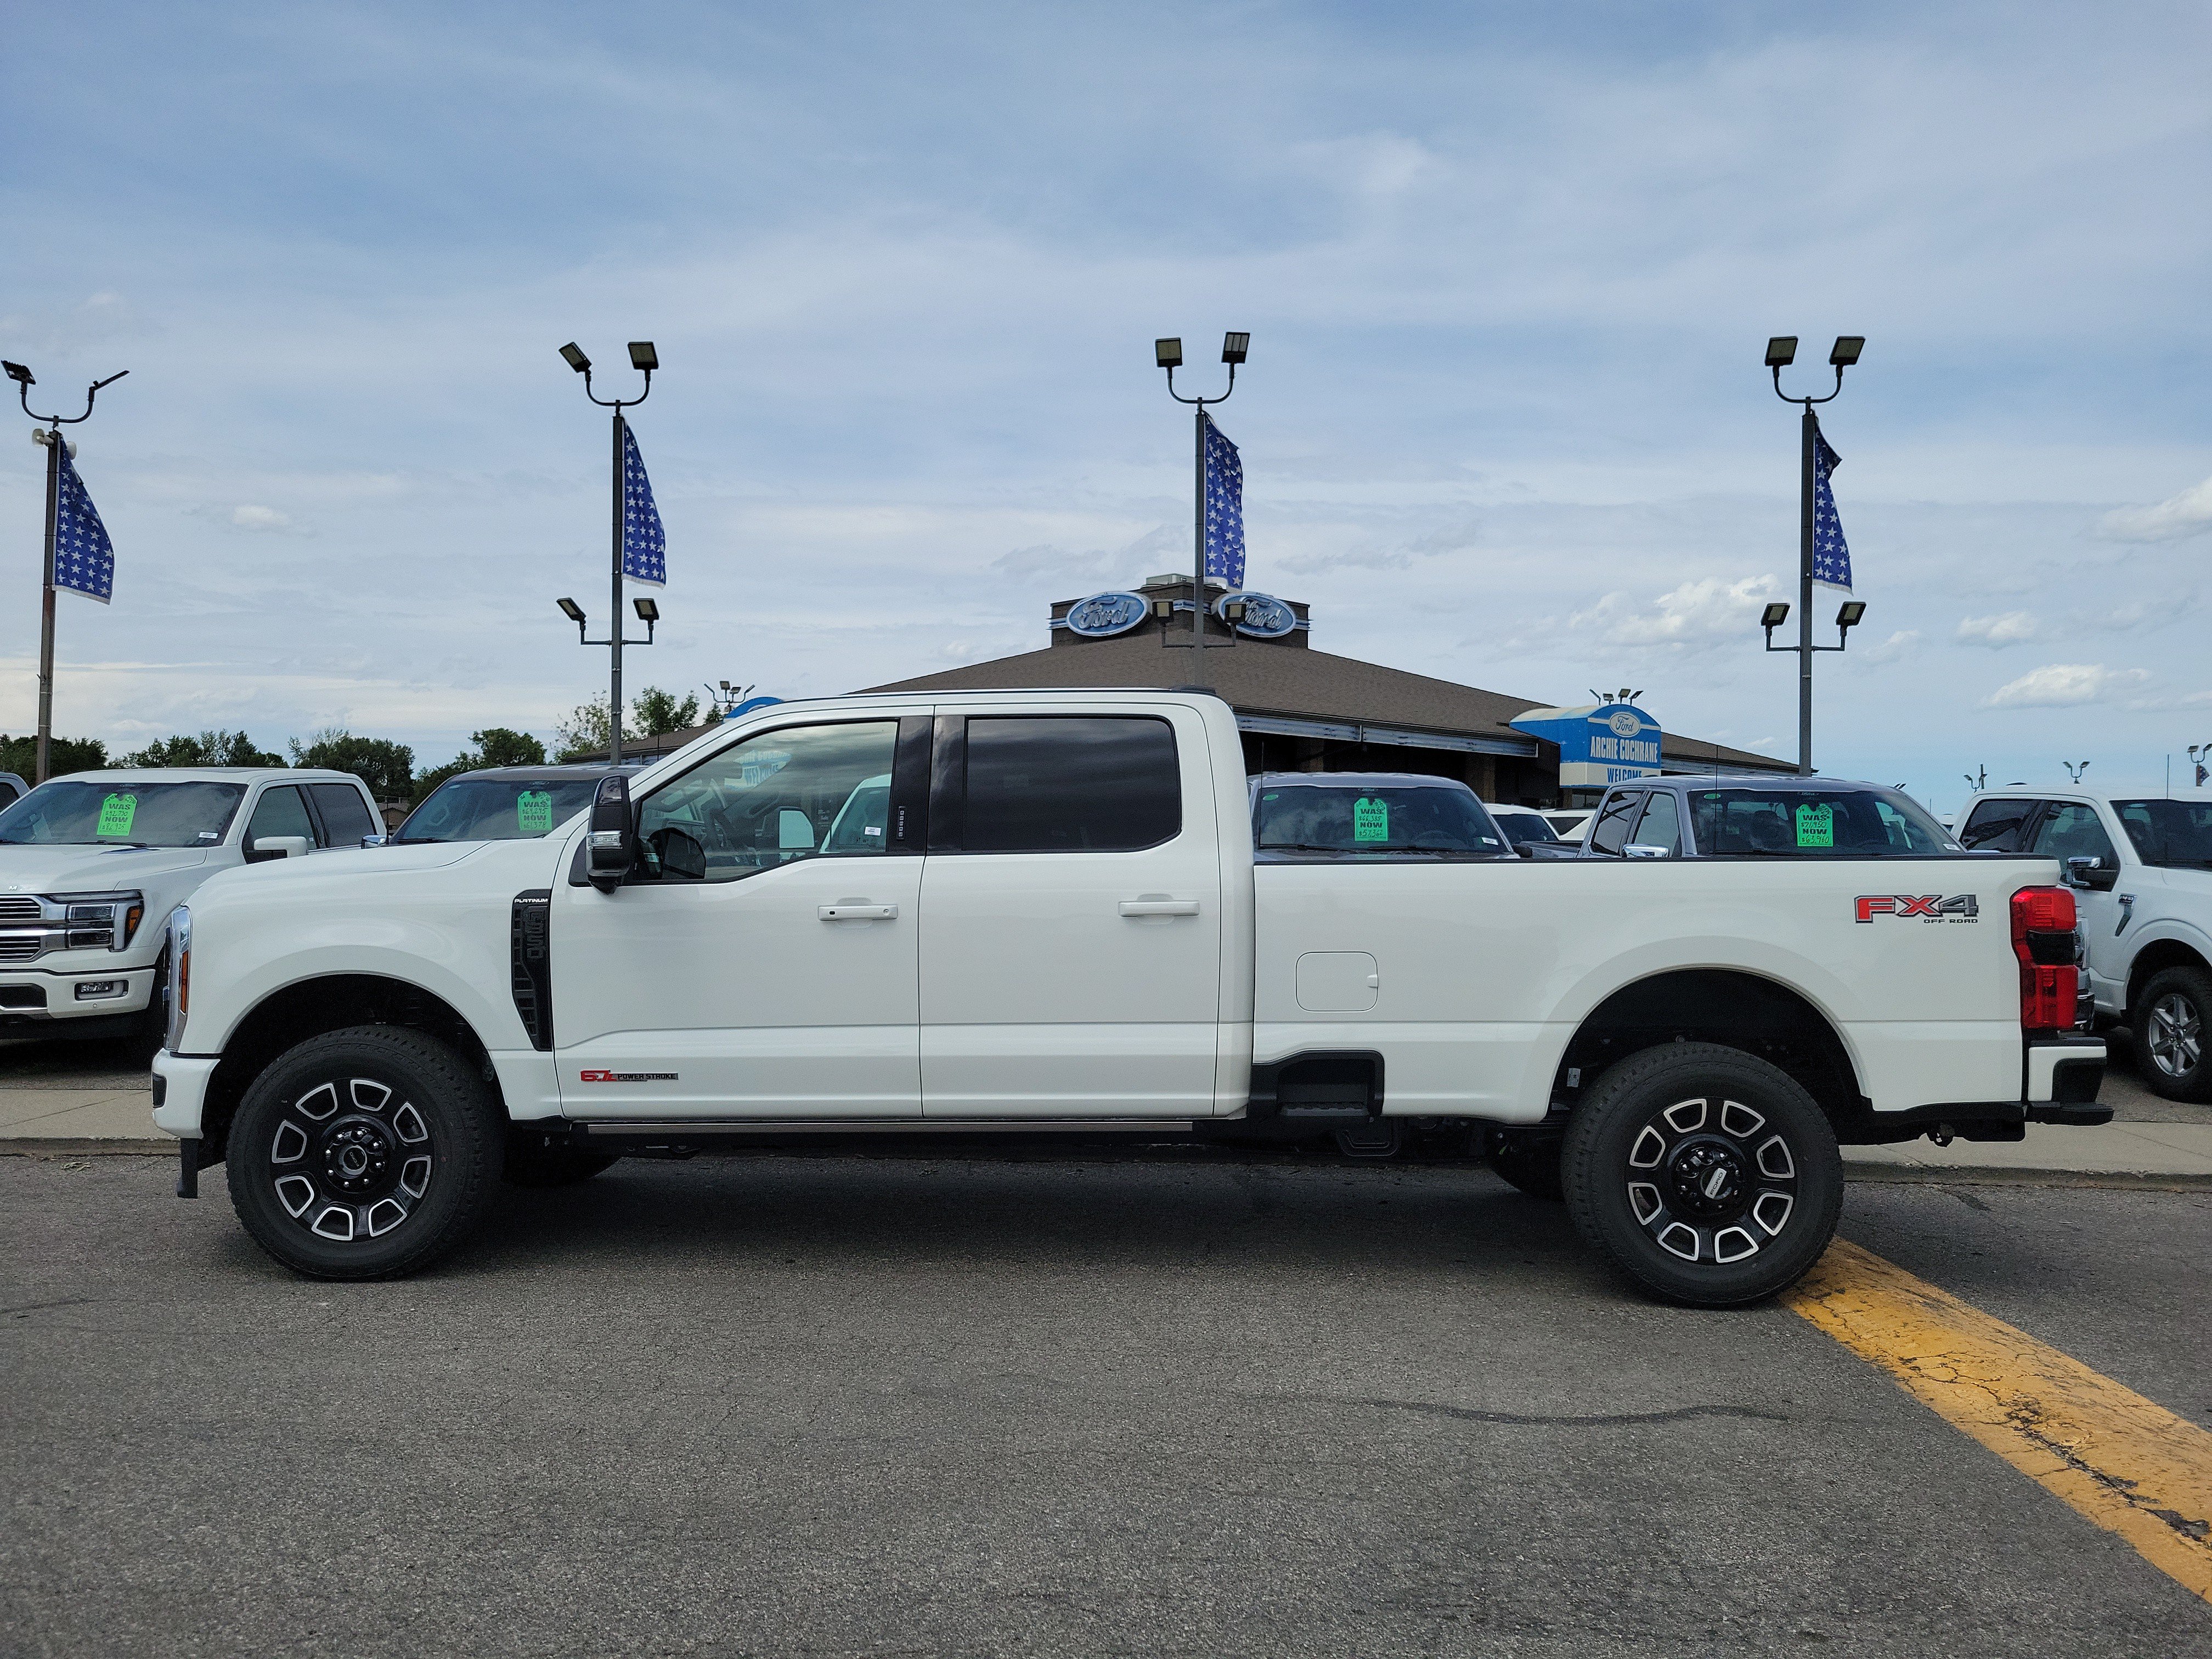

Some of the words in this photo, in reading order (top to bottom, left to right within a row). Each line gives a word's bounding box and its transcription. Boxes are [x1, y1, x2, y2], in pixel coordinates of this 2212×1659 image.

[1078, 596, 1129, 628] Ford
[1244, 597, 1284, 630] Ford
[1616, 716, 1634, 732] Ford
[1590, 736, 1618, 760] ARCHIE
[1620, 739, 1658, 763] COCHRANE
[1854, 894, 1979, 923] FX4
[1710, 1172, 1723, 1195] FORD
